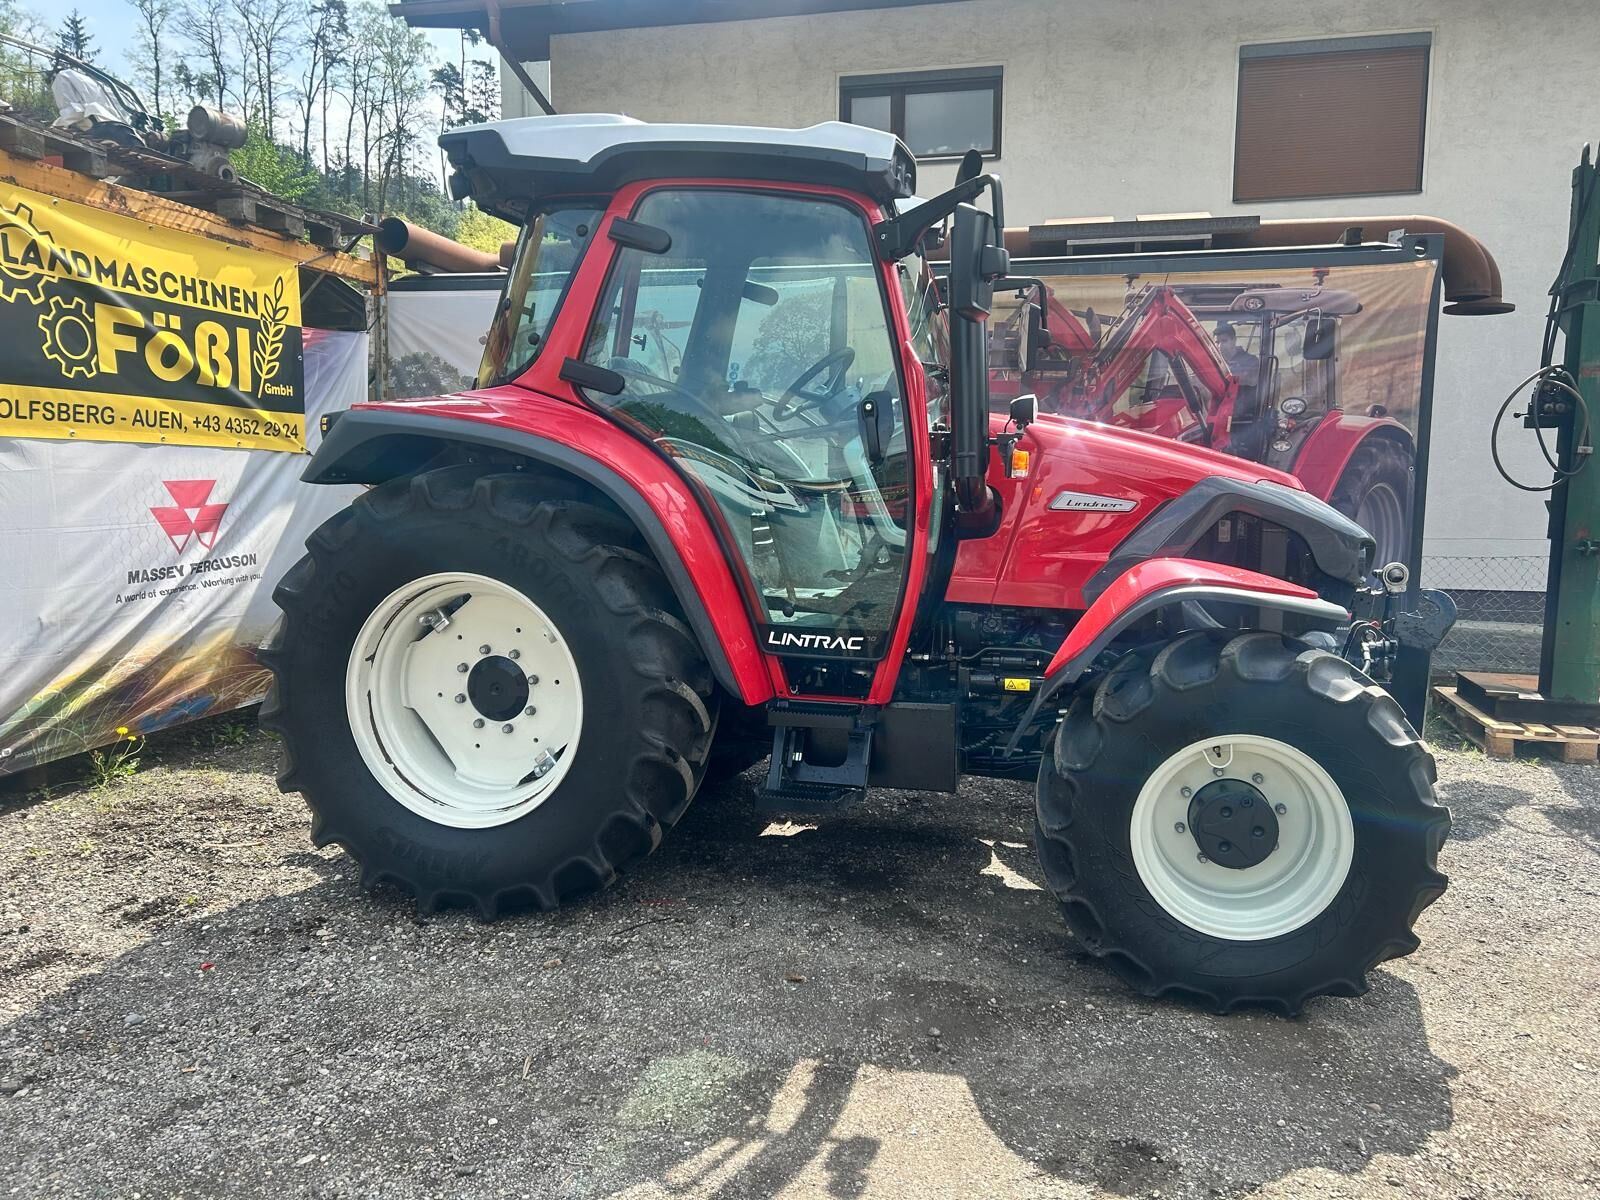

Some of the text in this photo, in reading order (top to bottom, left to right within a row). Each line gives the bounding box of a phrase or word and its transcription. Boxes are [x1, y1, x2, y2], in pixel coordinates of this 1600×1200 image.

[1, 232, 259, 316] LANDMASCHINEN
[264, 383, 293, 397] GmbH
[132, 408, 188, 433] AUEN,
[193, 415, 220, 432] +43
[225, 418, 259, 435] 4352
[1066, 499, 1123, 508] Lindner
[127, 554, 257, 584] MASSEY FERGUSON
[115, 594, 122, 604] A
[124, 591, 147, 603] world
[200, 577, 234, 589] Working
[235, 573, 249, 584] with
[249, 572, 263, 582] you.
[768, 631, 864, 650] LINTRAC
